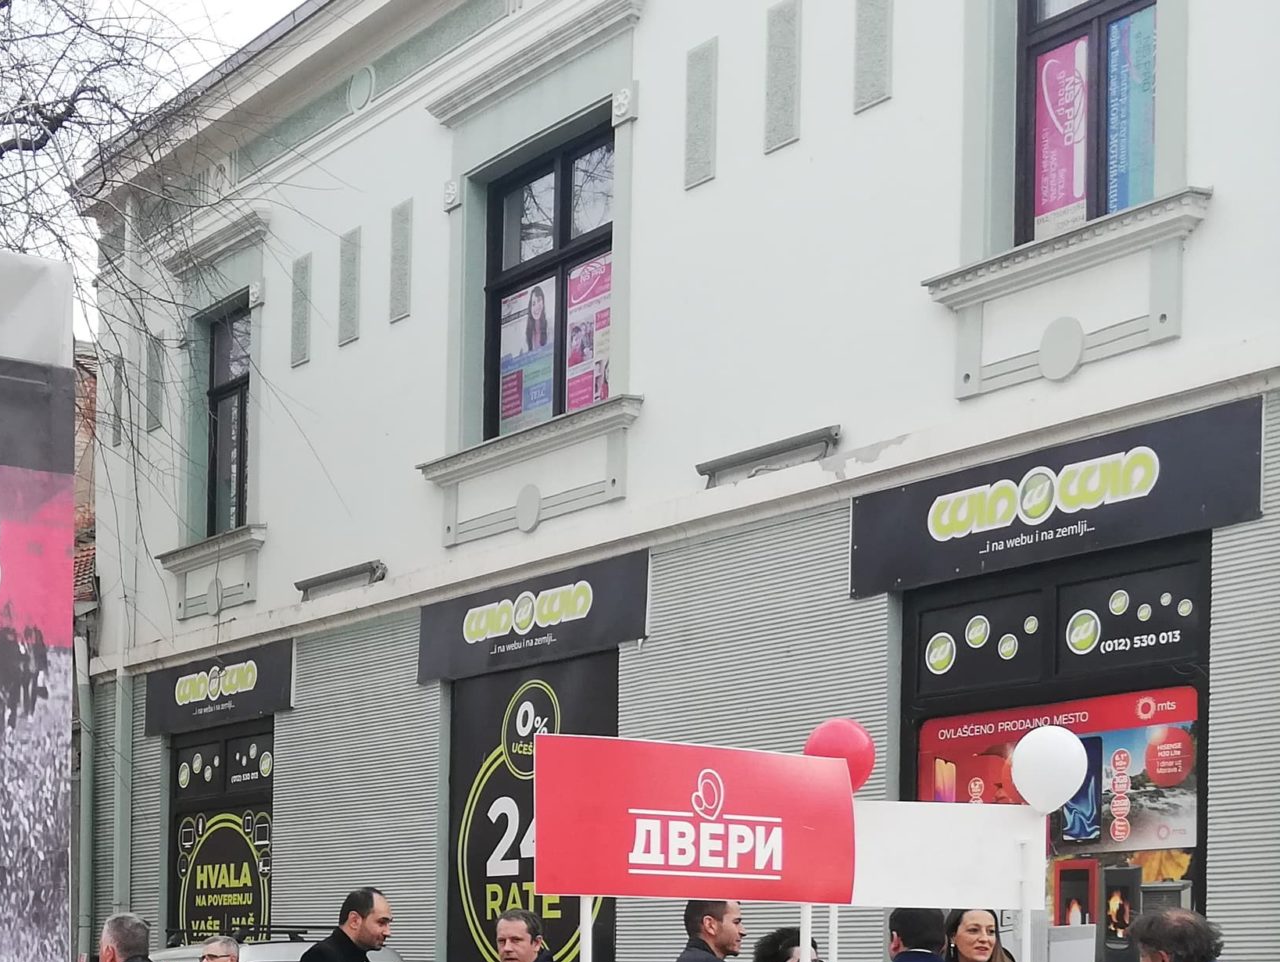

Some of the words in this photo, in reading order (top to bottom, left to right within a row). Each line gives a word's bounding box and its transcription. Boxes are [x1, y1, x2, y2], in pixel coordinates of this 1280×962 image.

[1064, 76, 1075, 103] NS
[1064, 107, 1074, 146] PRO
[991, 540, 1005, 552] na
[1006, 532, 1034, 549] webu
[1041, 530, 1054, 542] na
[1100, 637, 1131, 654] (012)
[1133, 634, 1156, 649] 530
[1159, 630, 1181, 645] 013
[1157, 701, 1176, 711] mts
[938, 723, 994, 740] OVLAŠĆENO
[998, 716, 1050, 732] PRODAJNO
[1053, 711, 1089, 726] MESTO
[511, 742, 534, 755] UČEŠ
[628, 818, 783, 871] ДВЕРИ
[196, 862, 252, 889] HVALA
[195, 894, 206, 907] NA
[207, 893, 253, 907] POVERENJU
